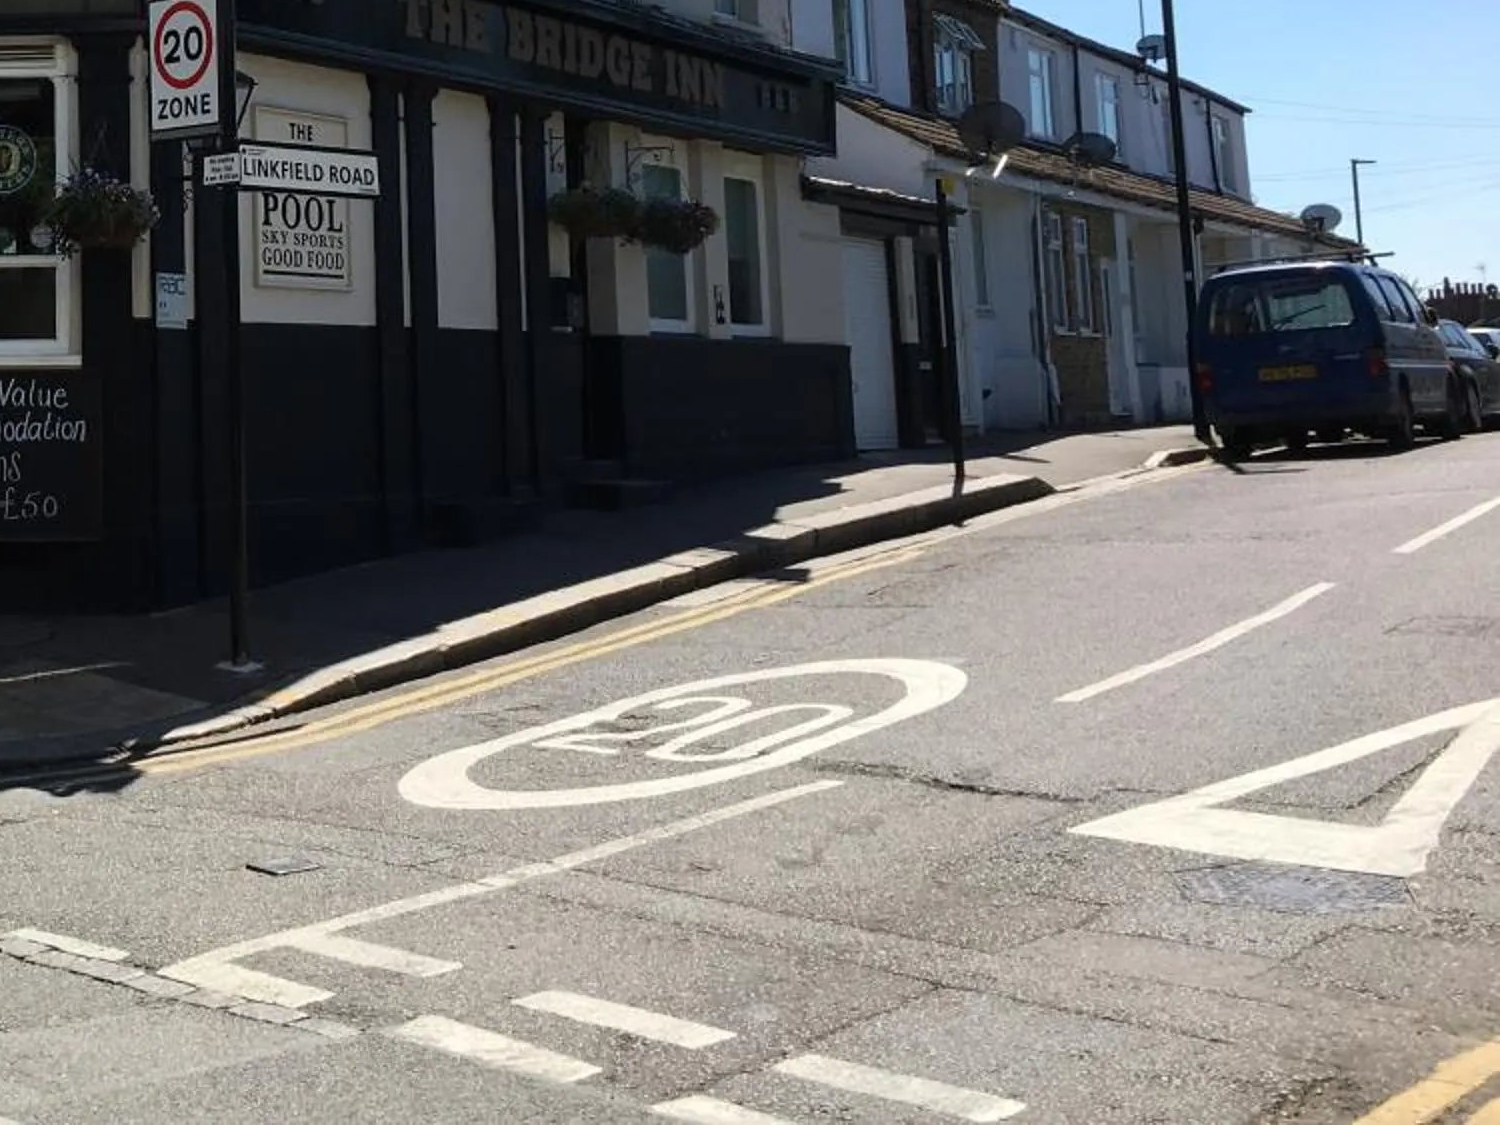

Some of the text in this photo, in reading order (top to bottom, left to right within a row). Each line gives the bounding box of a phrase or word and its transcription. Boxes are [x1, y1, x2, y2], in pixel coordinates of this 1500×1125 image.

[163, 25, 203, 64] 20
[504, 5, 653, 92] BRIDGE
[663, 48, 726, 109] INN
[157, 92, 212, 121] ZONE
[288, 122, 315, 143] THE
[243, 156, 325, 183] LINKFIELD
[328, 164, 376, 187] ROAD
[261, 191, 344, 234] POOL
[261, 229, 345, 250] SKY SPORTS
[261, 246, 345, 271] GOOD FOOD
[531, 695, 855, 763] 20
